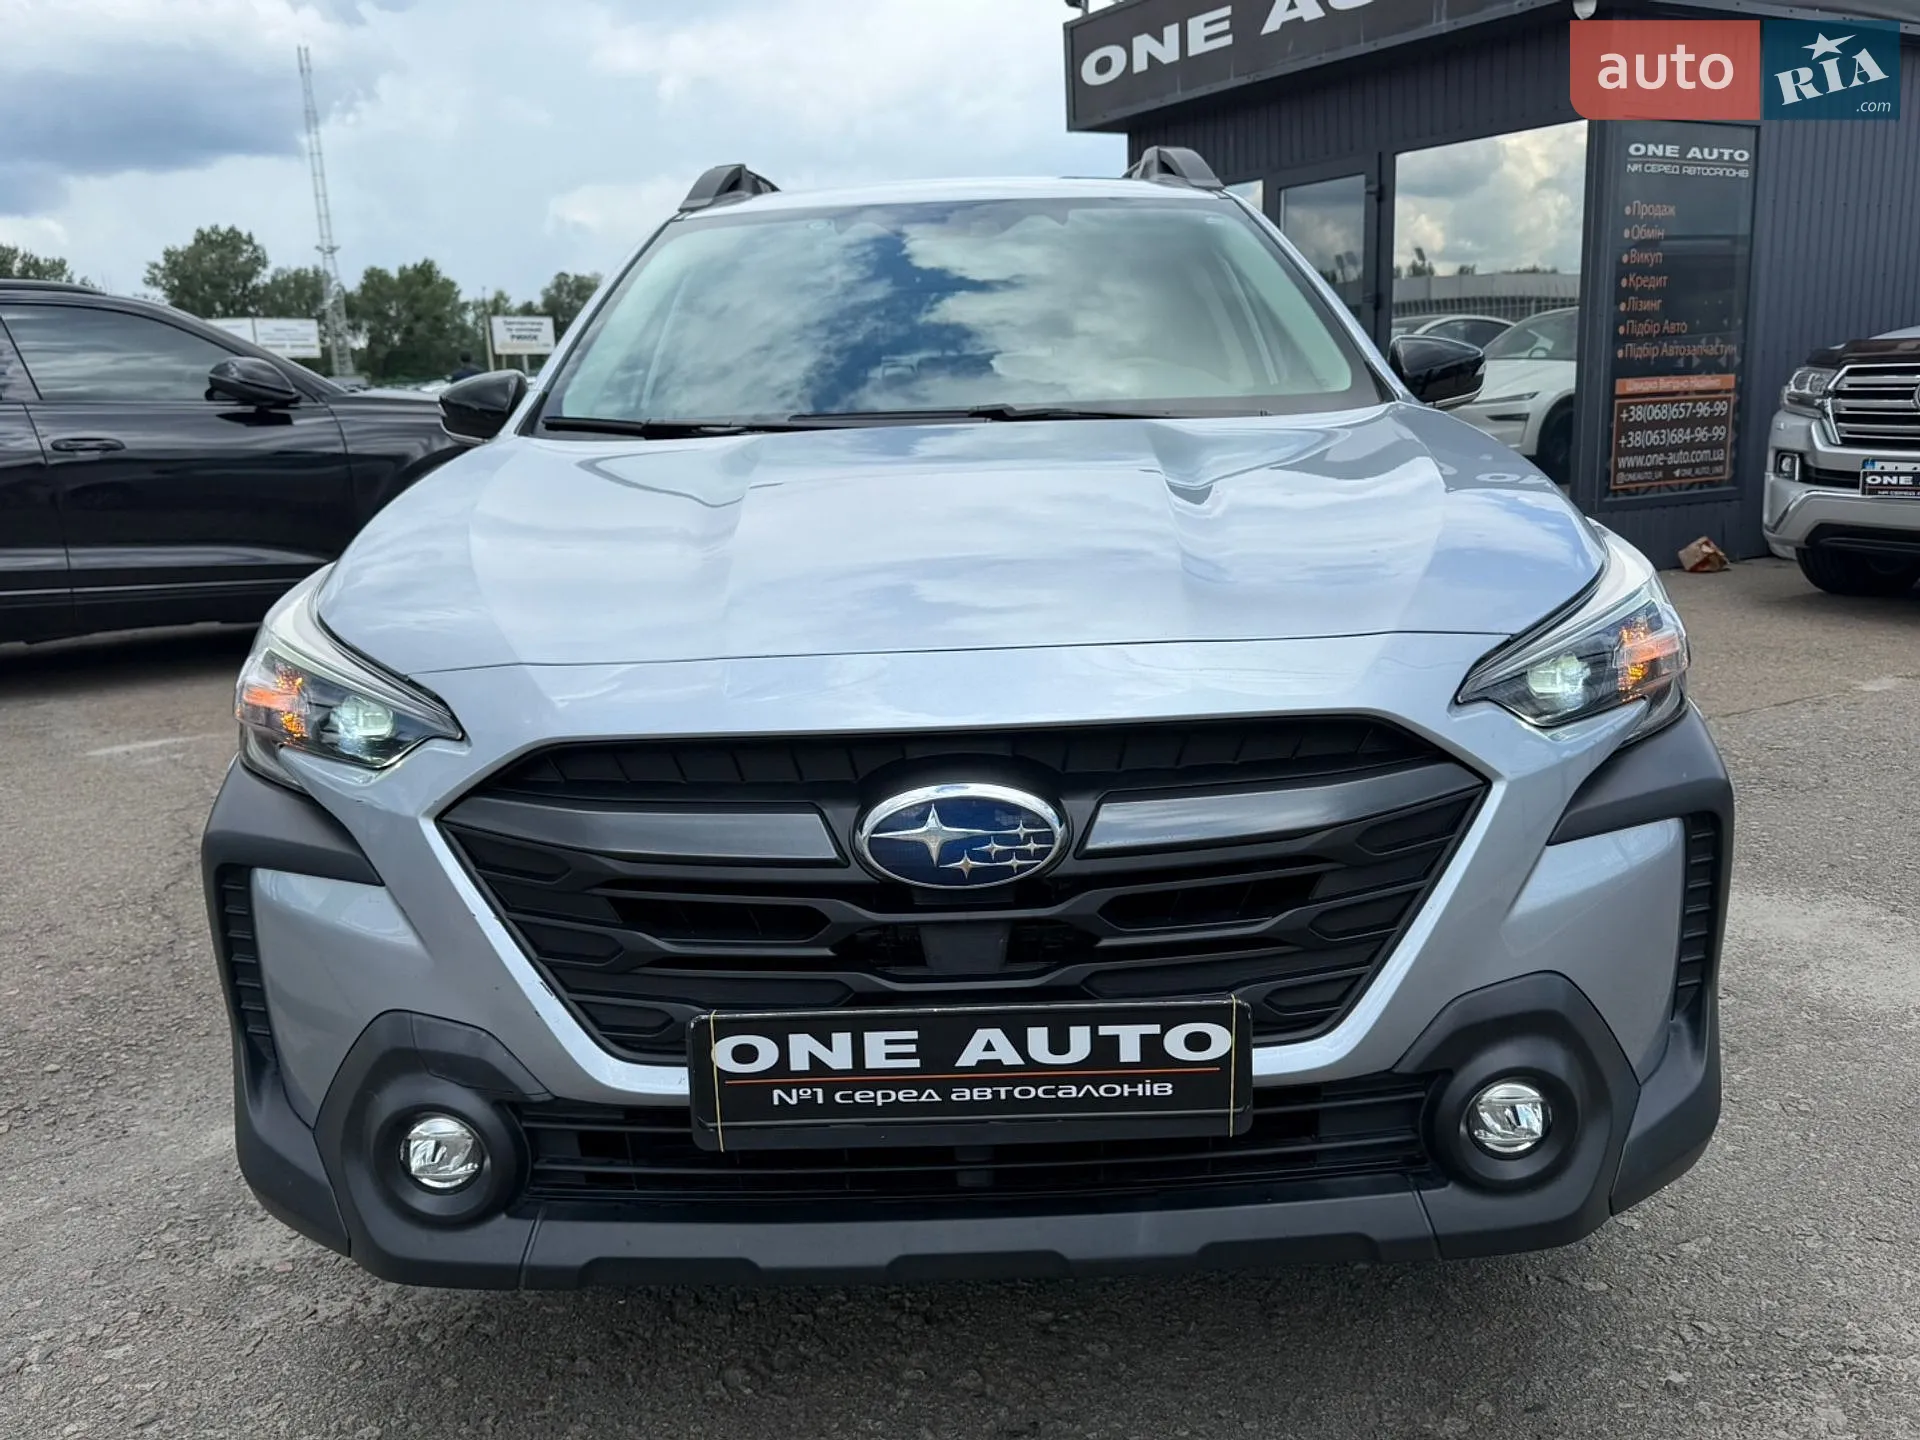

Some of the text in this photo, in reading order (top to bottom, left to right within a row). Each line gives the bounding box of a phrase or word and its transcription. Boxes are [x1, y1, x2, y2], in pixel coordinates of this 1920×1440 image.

[1080, 5, 1233, 86] ONE
[1628, 143, 1750, 162] ONE AUTO
[1632, 200, 1676, 218] Продаж
[1631, 223, 1665, 240] Обмін
[1630, 248, 1663, 267] Викуп
[1628, 272, 1668, 290] Кредит
[1626, 296, 1662, 311] Лізинг
[1626, 320, 1688, 337] Підбір Авто
[1624, 341, 1737, 360] Підбір Автозапчастин
[1620, 401, 1728, 423] +38(068)657-96-99
[1618, 425, 1727, 449] +38(063)684-96-99
[1617, 448, 1725, 469] www.one-auto.com.ua
[1866, 475, 1913, 485] ONE
[711, 1022, 1233, 1073] ONE AUTO
[772, 1078, 1174, 1107] №1 серед автосалонів
